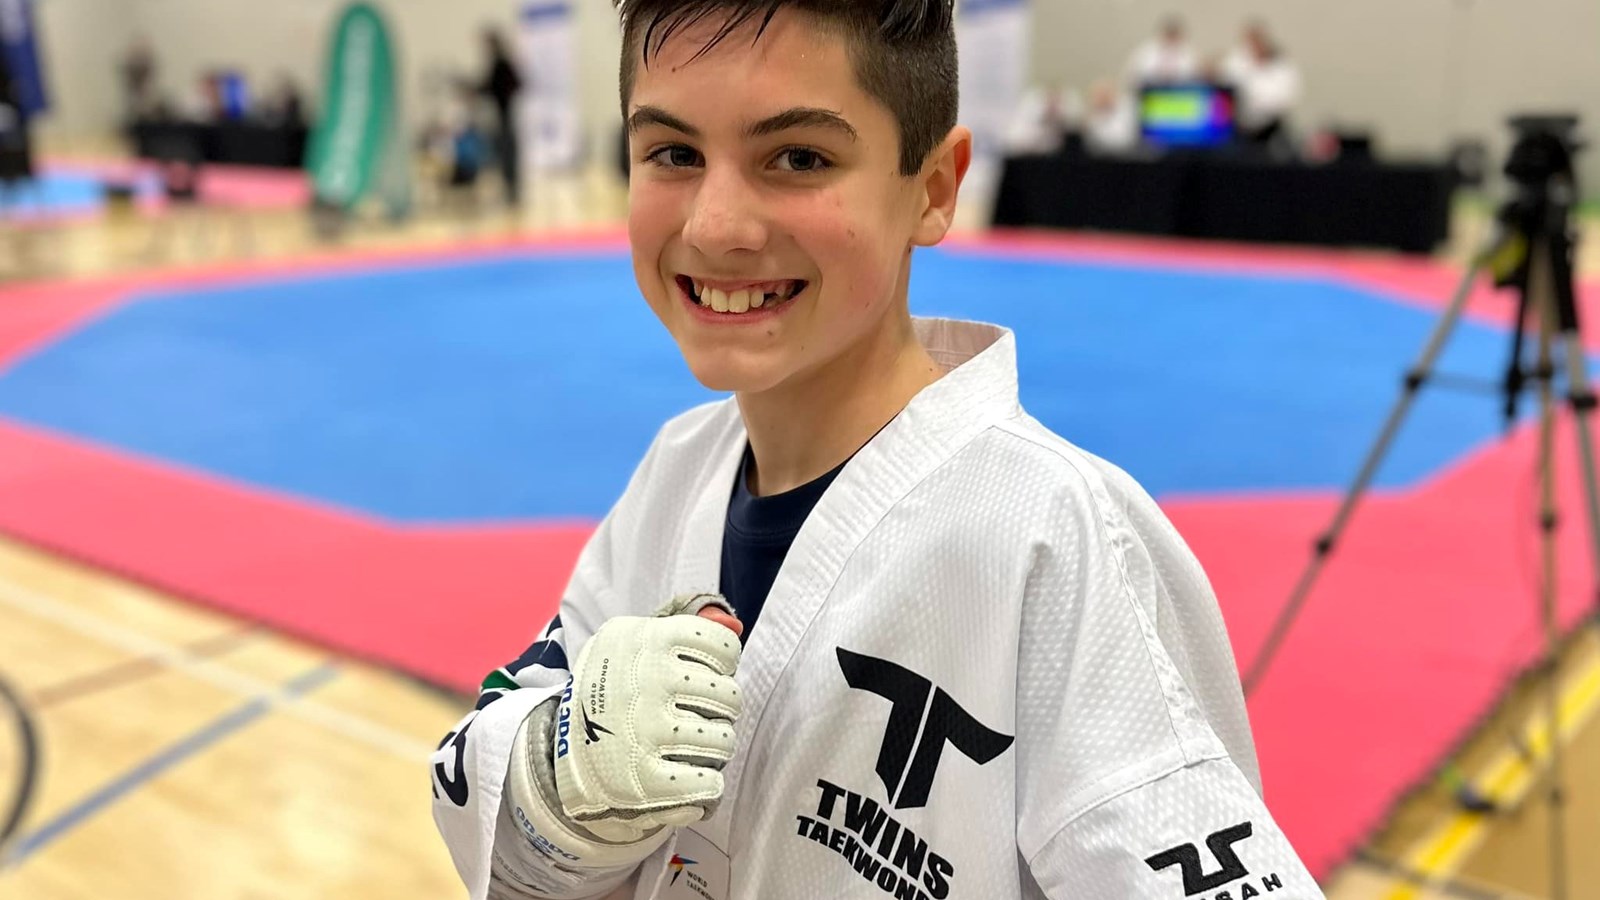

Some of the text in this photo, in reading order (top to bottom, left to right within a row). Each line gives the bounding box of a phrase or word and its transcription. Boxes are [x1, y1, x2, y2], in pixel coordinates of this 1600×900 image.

[599, 658, 609, 714] TAEKWONDO
[816, 778, 954, 900] TWINS
[686, 870, 708, 888] WORLD
